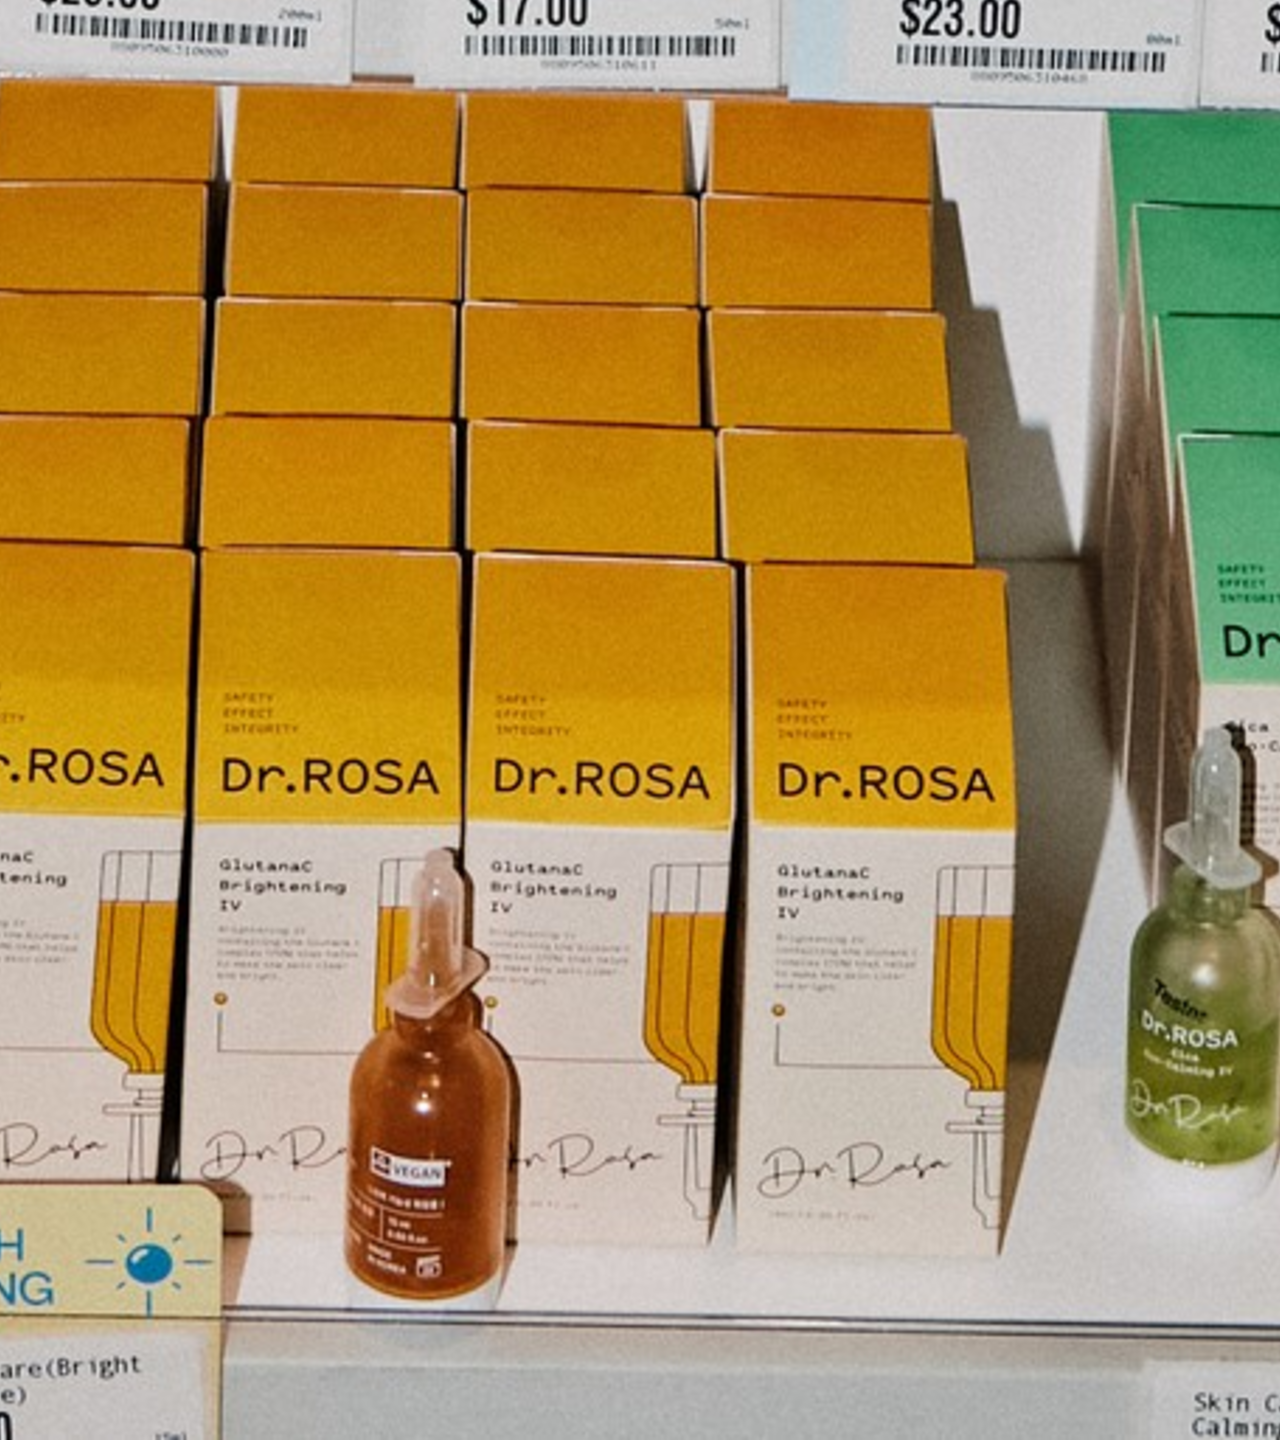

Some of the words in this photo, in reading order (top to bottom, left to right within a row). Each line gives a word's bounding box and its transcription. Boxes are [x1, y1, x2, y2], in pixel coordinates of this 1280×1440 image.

[222, 757, 441, 795] Dr.ROSA
[493, 759, 711, 802] Dr.ROSA
[777, 762, 996, 804] Dr.ROSA
[393, 1161, 443, 1180] VEGAN
